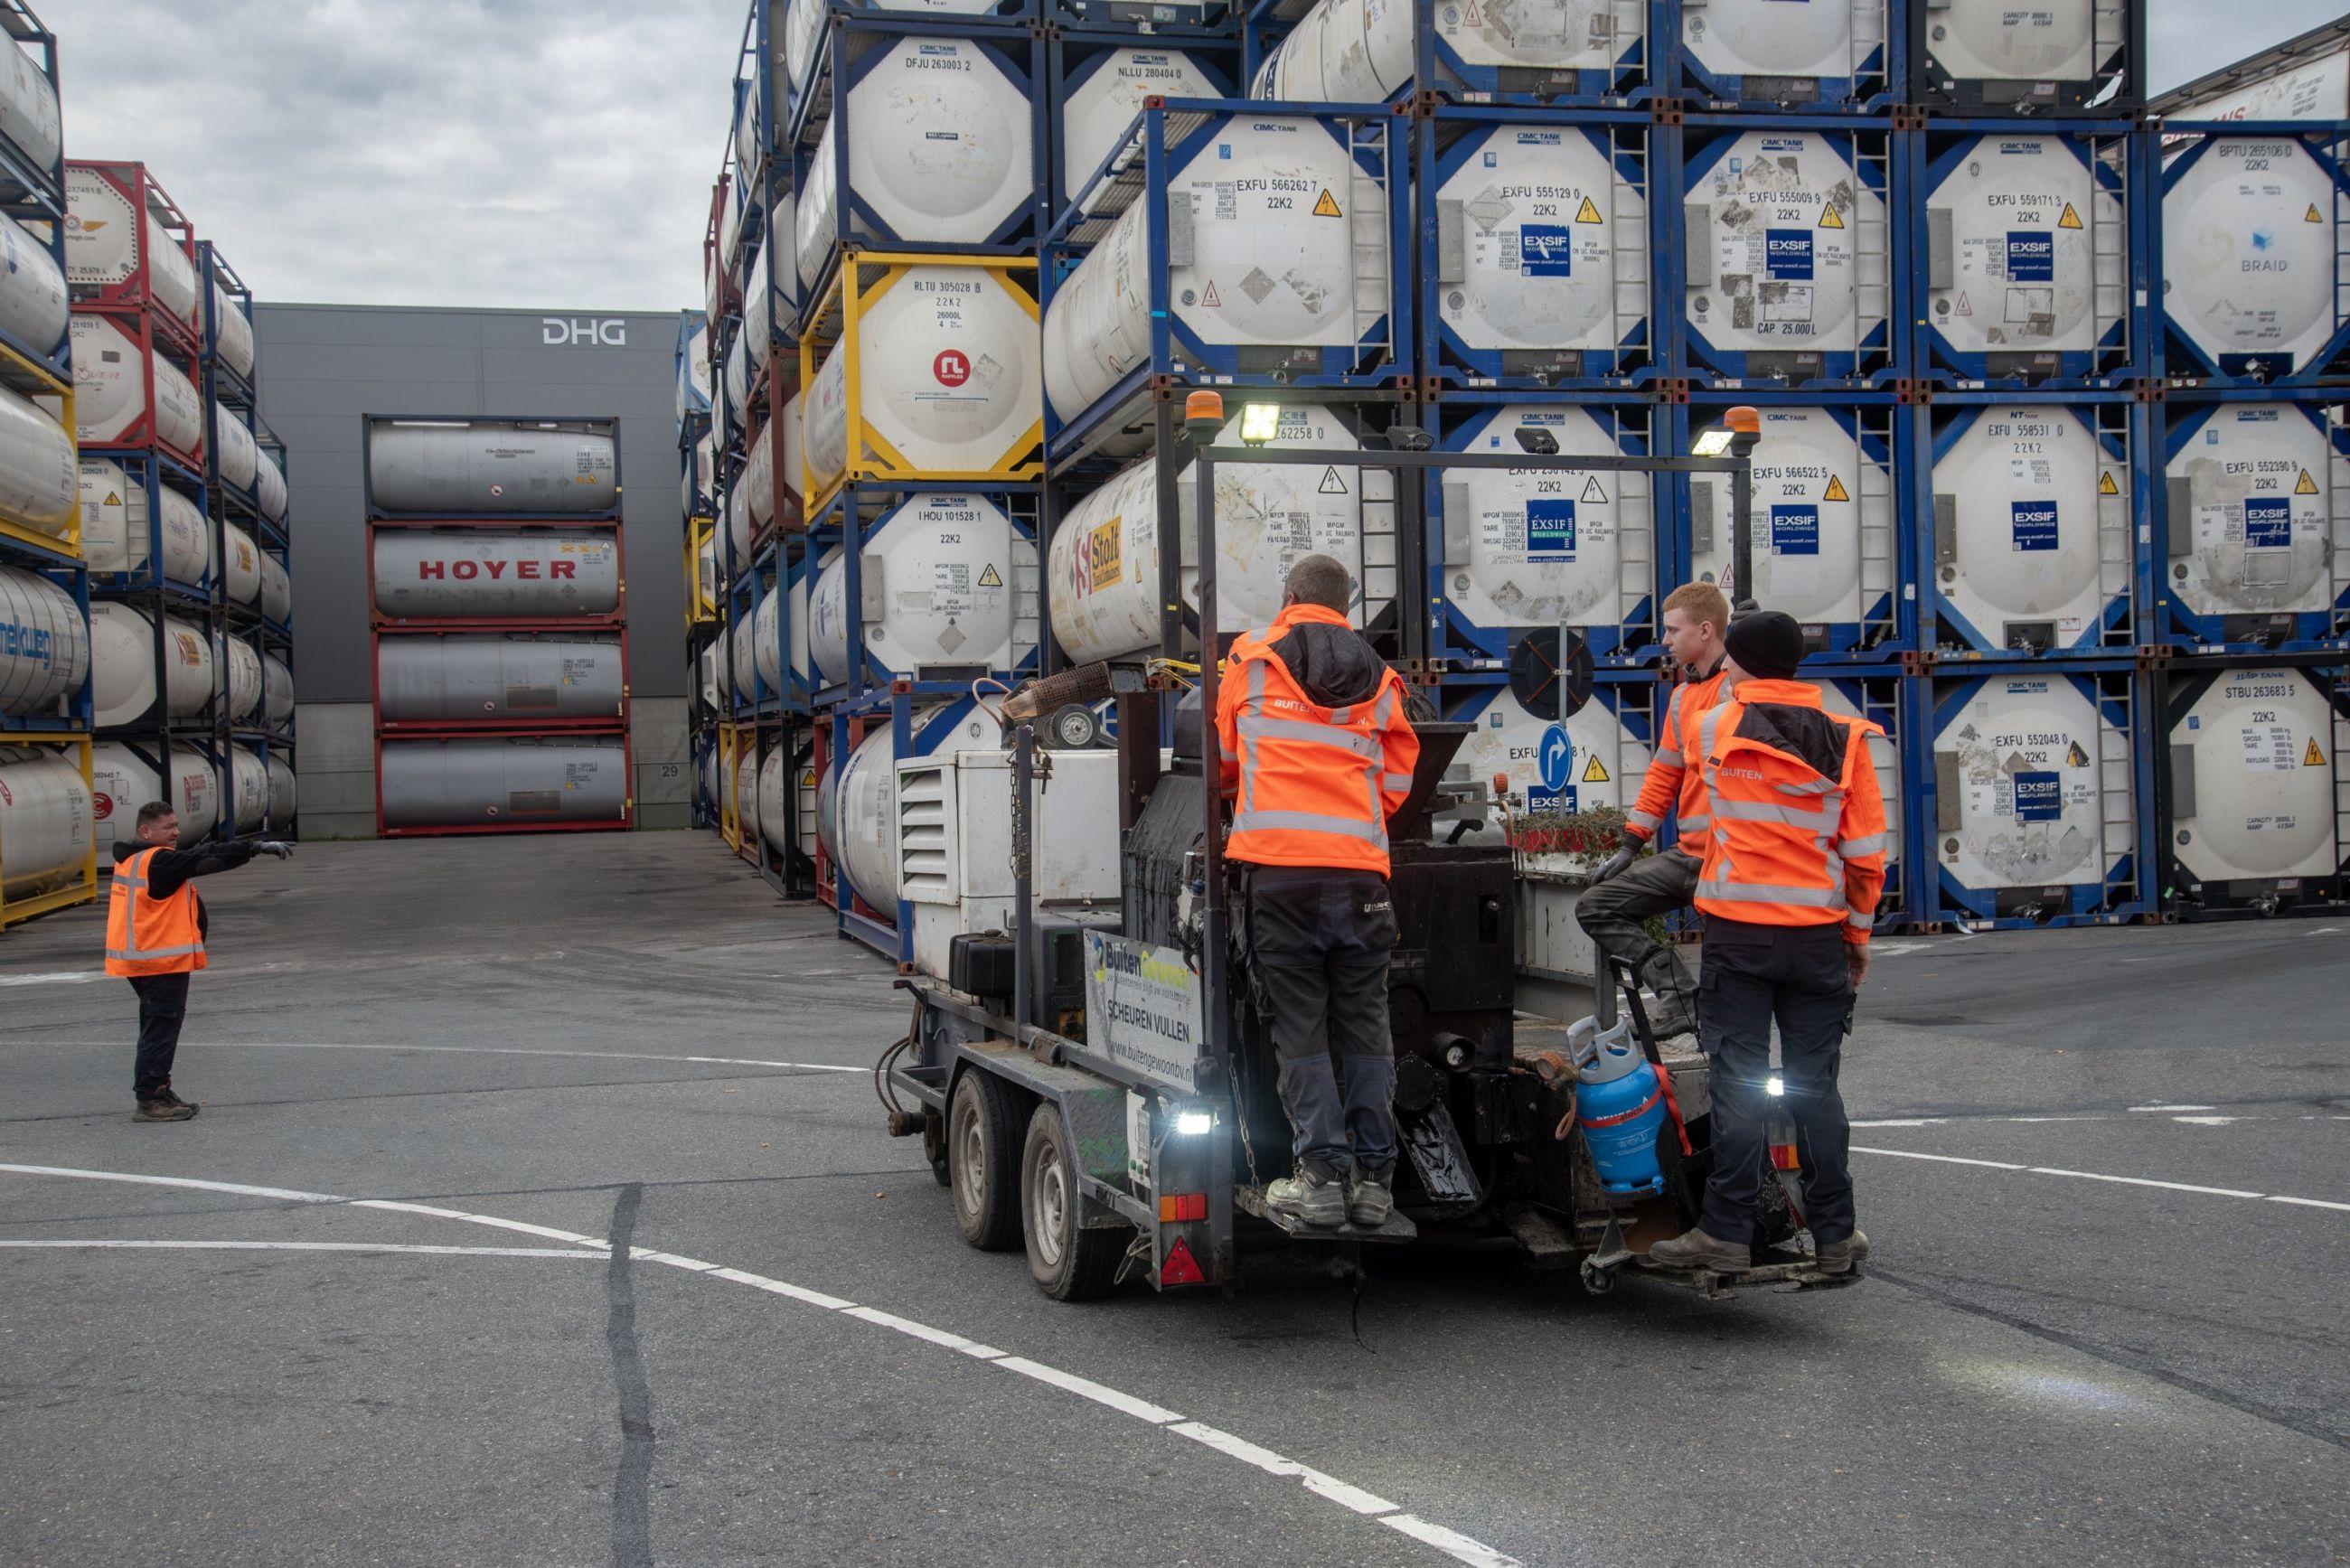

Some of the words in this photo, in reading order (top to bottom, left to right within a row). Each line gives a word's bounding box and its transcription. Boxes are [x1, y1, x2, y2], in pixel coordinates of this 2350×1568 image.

[906, 58, 929, 69] DFJU
[931, 60, 962, 70] 263003
[965, 61, 971, 71] 2
[1118, 67, 1141, 77] NLLU
[1144, 69, 1174, 78] 280404
[1176, 69, 1182, 80] 0
[1253, 123, 1276, 131] CIMC
[1517, 133, 1537, 141] CIMC
[1539, 133, 1561, 141] TANK
[2220, 145, 2247, 157] BPTU
[2249, 145, 2285, 157] 265106
[2245, 159, 2269, 170] 22K2
[1236, 179, 1267, 192] EXFU
[1272, 179, 1308, 192] 566262
[1311, 181, 1316, 192] 7
[1502, 186, 1531, 197] EXFU
[1537, 186, 1571, 198] 555129
[1574, 188, 1580, 199] 0
[1750, 192, 1777, 202] EXFU
[1781, 192, 1811, 202] 555009
[1815, 193, 1820, 204] 9
[1267, 197, 1292, 210] 22K2
[1988, 195, 2016, 206] EXFU
[2020, 195, 2053, 206] 559171
[2055, 196, 2061, 206] 3
[1533, 204, 1557, 216] 22K2
[1777, 209, 1800, 221] 22K2
[2017, 211, 2040, 222] 22K2
[1524, 237, 1567, 246] EXSIF
[1770, 240, 1810, 249] EXSIF
[2010, 242, 2051, 252] EXSIF
[2242, 260, 2288, 271] BRAID
[914, 281, 935, 291] RLTU
[940, 282, 971, 293] 305028
[936, 311, 962, 319] 26000L
[542, 318, 625, 345] DHG
[1318, 427, 1324, 439] 0
[1988, 425, 2010, 436] EXFU
[2017, 425, 2049, 437] 558531
[2057, 425, 2063, 437] 0
[2014, 443, 2043, 454] 22K2
[1753, 467, 1781, 479] EXFU
[1786, 466, 1819, 478] 566522
[1822, 467, 1828, 478] 5
[2226, 463, 2254, 474] EXFU
[2258, 461, 2289, 472] 552390
[2292, 461, 2298, 472] 9
[1537, 481, 1562, 493] 22K2
[1782, 484, 1806, 495] 22K2
[2255, 478, 2278, 490] 22K2
[945, 512, 974, 521] 101528
[976, 512, 982, 522] 1
[2015, 512, 2055, 522] EXSIF
[2248, 509, 2289, 519] EXSIF
[1531, 519, 1565, 530] EXSIF
[1774, 515, 1816, 526] EXSIF
[940, 533, 962, 544] 22K2
[1093, 522, 1120, 570] Stolt
[419, 560, 577, 580] HOYER
[2225, 687, 2251, 698] STBU
[2253, 686, 2286, 698] 263683
[2289, 685, 2295, 696] 5
[2252, 711, 2276, 723] 22K2
[1996, 735, 2023, 746] EXFU
[2027, 734, 2060, 745] 552048
[2063, 733, 2068, 745] 0
[1509, 747, 1538, 759] EXFU
[2025, 752, 2048, 763] 22K2
[663, 766, 678, 777] 29
[1721, 767, 1762, 781] BUITEN
[2017, 782, 2058, 793] EXSIF
[1531, 796, 1574, 808] EXSF
[1107, 1000, 1152, 1032] SCHEUREN
[1154, 1014, 1189, 1044] VULLEN
[1110, 1041, 1193, 1083] www.buitengewoonbv.nl
